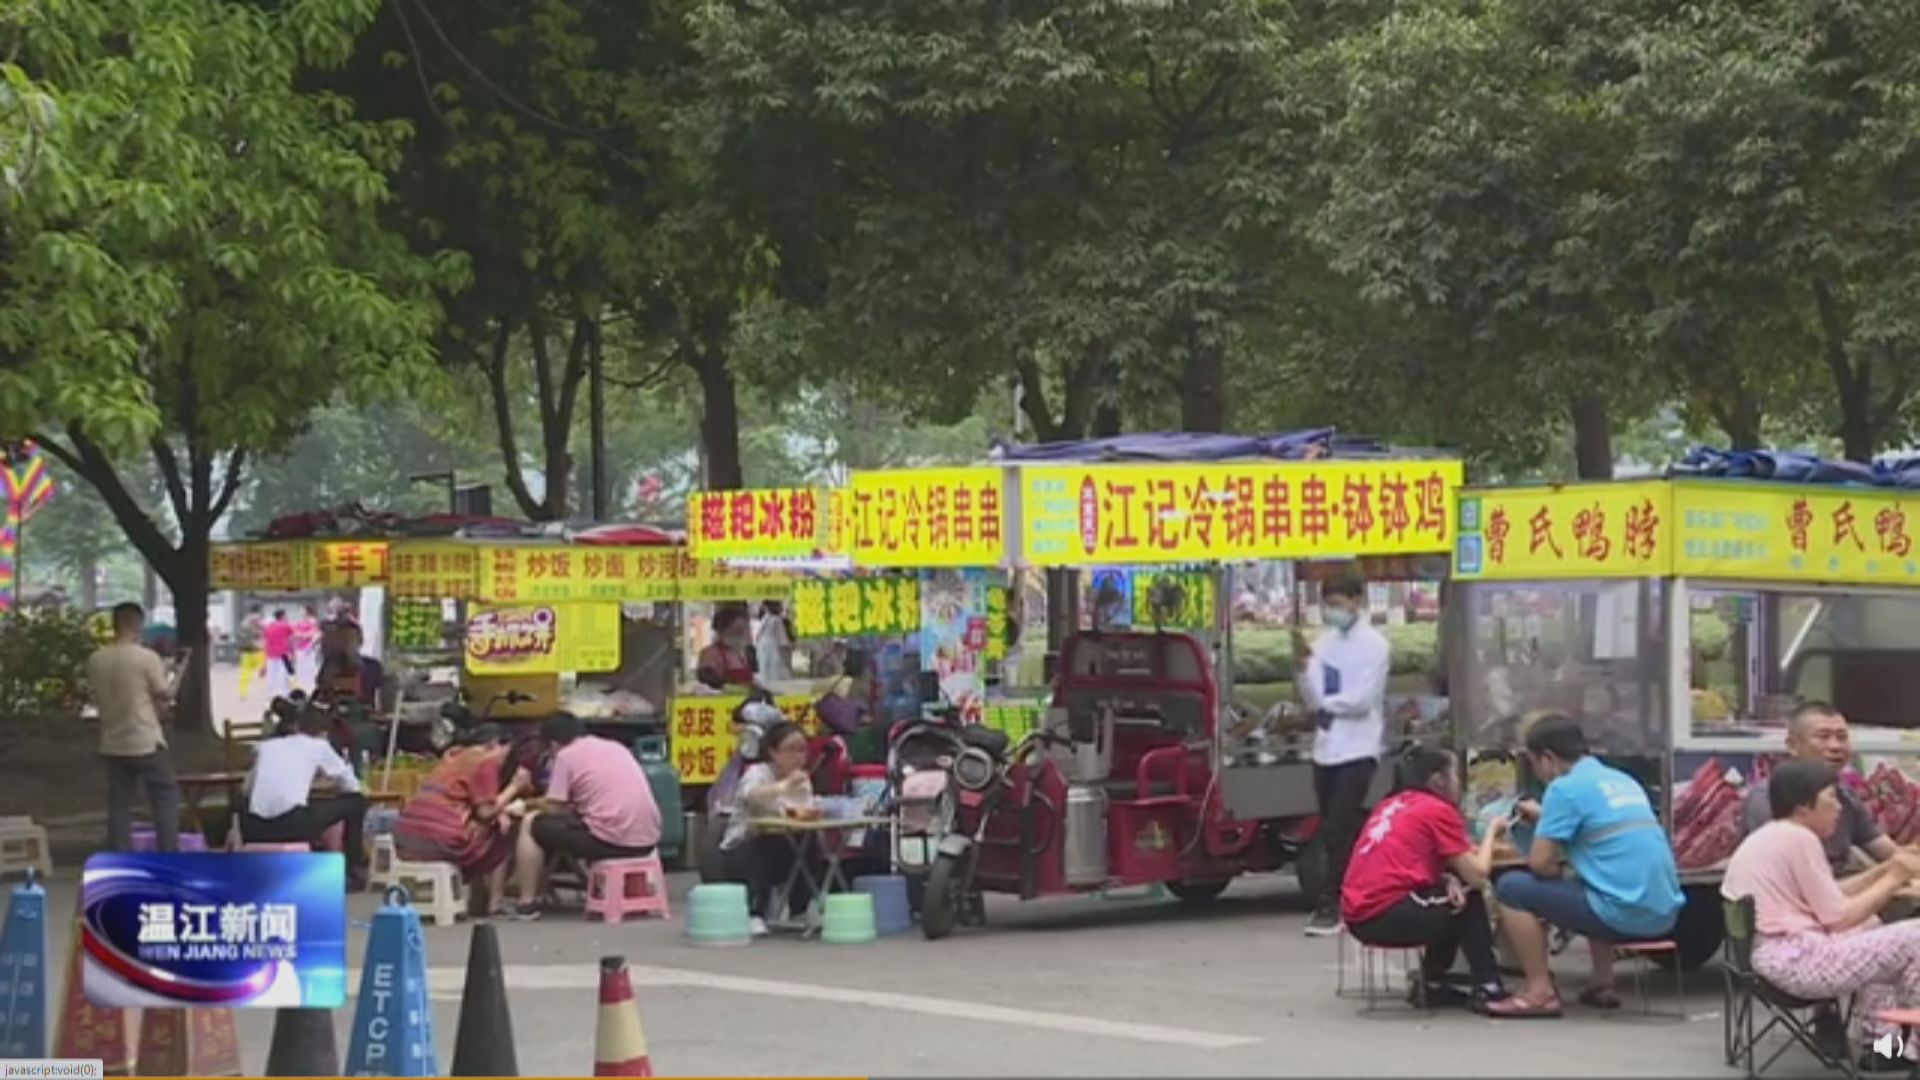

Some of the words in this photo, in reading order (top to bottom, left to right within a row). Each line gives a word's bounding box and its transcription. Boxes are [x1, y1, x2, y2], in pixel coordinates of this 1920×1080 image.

[852, 480, 1000, 552] 江记冷锅串串
[1103, 470, 1446, 549] 江记冷锅串串·钵钵鸡
[1485, 499, 1660, 565] 曹氏鸭脖
[1785, 494, 1912, 557] 曹氏鸭
[527, 552, 570, 579] 炒饭
[583, 552, 625, 579] 炒面
[365, 963, 395, 1067] ETCP
